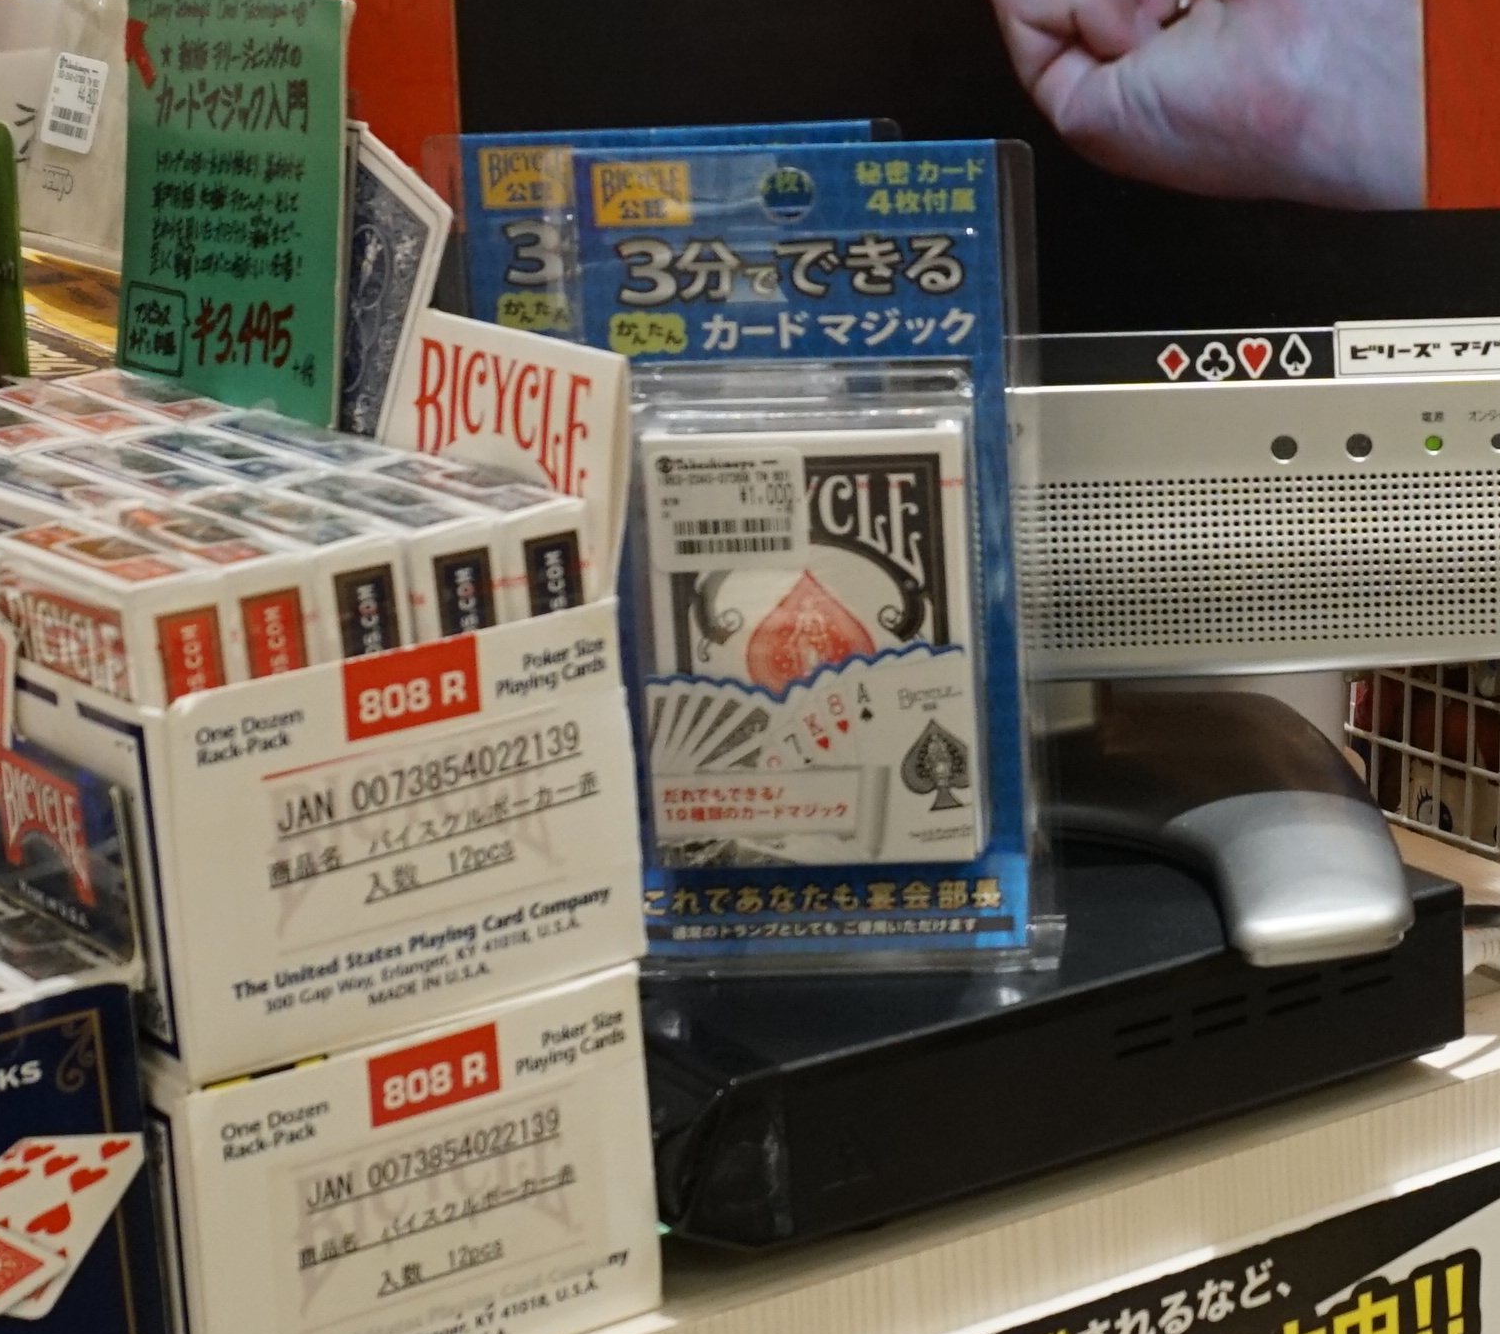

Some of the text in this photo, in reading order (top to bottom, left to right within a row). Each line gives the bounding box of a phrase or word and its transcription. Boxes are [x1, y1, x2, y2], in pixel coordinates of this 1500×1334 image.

[618, 233, 964, 305] 3分でできる
[703, 313, 810, 350] カード
[818, 309, 976, 347] マジック
[1349, 341, 1442, 361] ビリーズ
[414, 335, 594, 499] BICYCLE
[523, 636, 605, 671] Poker Size
[359, 670, 467, 723] 808 R
[496, 658, 607, 698] Playing Cards
[196, 708, 304, 745] One Dozen
[277, 722, 581, 833] JAN 0073854022139
[1, 757, 92, 899] BICYCLE
[366, 839, 515, 902] 入数 12pcs
[233, 886, 612, 1001] The United States Playing Card Company
[367, 984, 417, 1007] MADE
[515, 1028, 627, 1076] Playing Cards
[540, 1008, 624, 1049] Poker Size
[382, 1051, 488, 1112] 808 R
[220, 1100, 331, 1143] One Dozen
[223, 1122, 318, 1162] Rack-Pack
[306, 1108, 562, 1210] JAN 0073854022139
